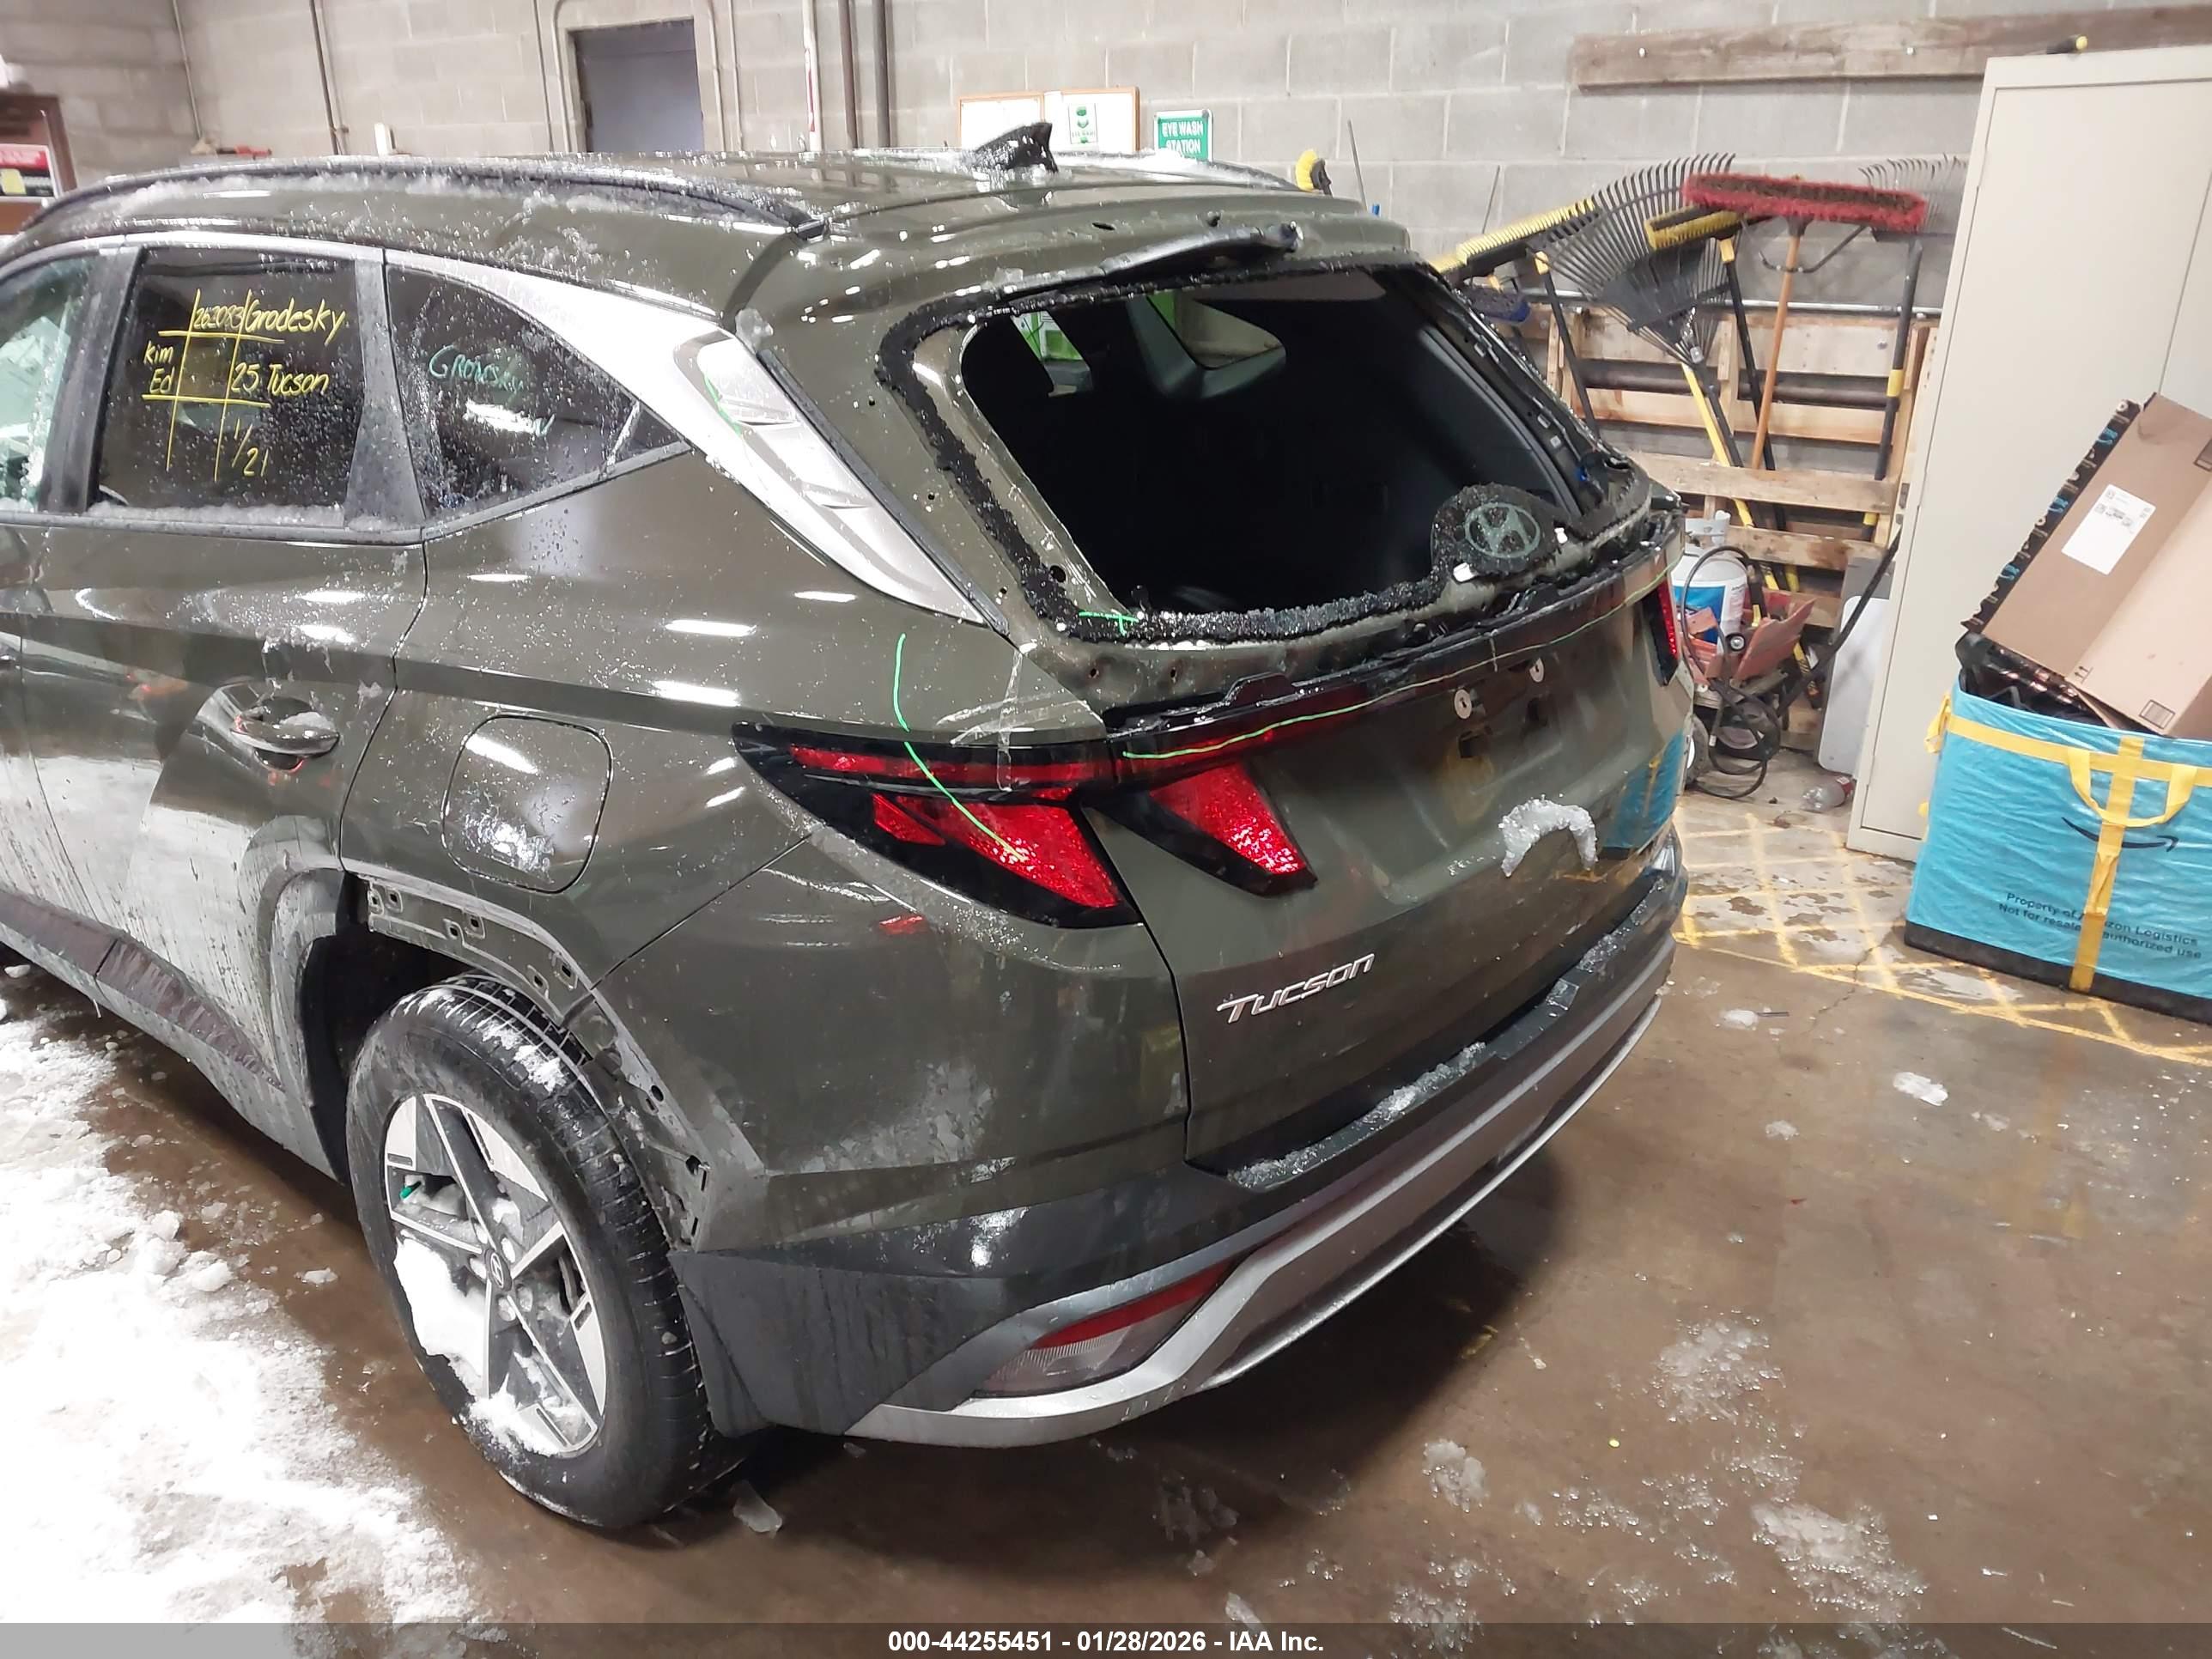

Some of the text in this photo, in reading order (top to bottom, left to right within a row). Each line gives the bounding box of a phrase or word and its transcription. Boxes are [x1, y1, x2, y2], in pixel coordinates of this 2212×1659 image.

[1162, 120, 1203, 137] EYE WASH
[245, 299, 345, 346] Grodesky
[149, 366, 174, 394] Ed
[231, 362, 329, 396] 25 Tucson
[1999, 903, 2020, 916] Not
[2023, 909, 2040, 921] for
[2045, 917, 2082, 932] resale
[2177, 948, 2202, 958] use
[2007, 893, 2057, 915] Property
[2136, 926, 2198, 945] Logistics
